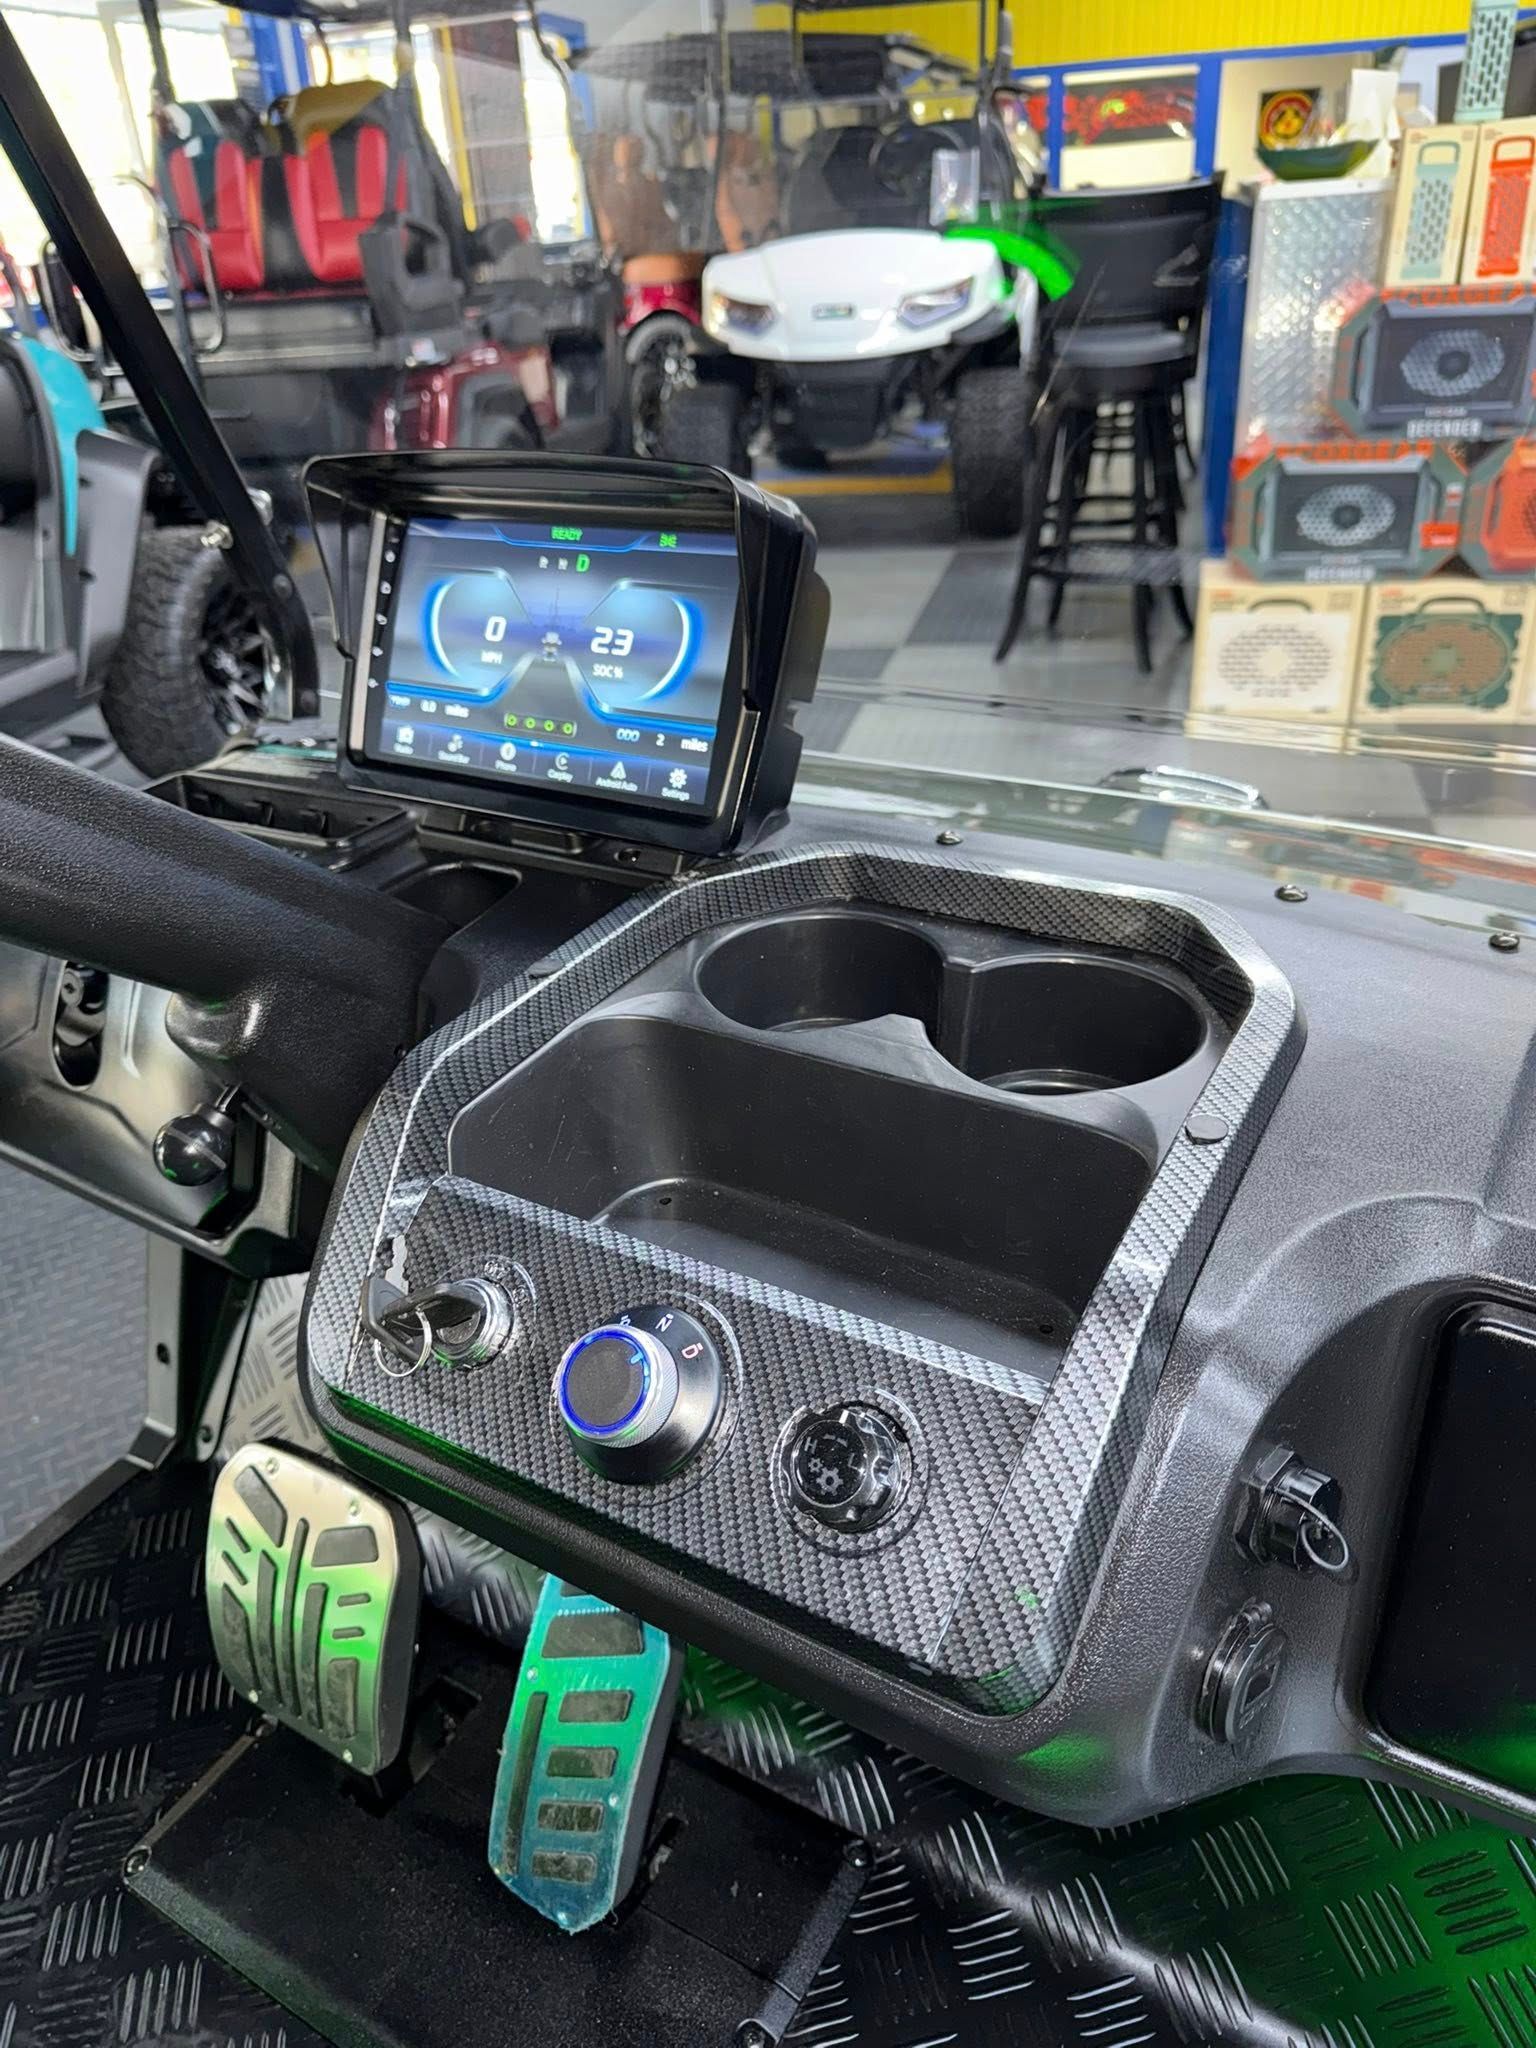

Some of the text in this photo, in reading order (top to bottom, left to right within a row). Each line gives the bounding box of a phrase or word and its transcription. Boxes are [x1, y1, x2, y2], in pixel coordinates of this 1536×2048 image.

[551, 525, 583, 541] READY
[576, 553, 590, 572] D
[485, 616, 507, 642] 0
[590, 626, 634, 656] 23
[481, 651, 503, 664] MPH
[656, 733, 665, 747] 2
[681, 738, 708, 753] miles
[661, 787, 690, 801] Settings
[655, 1316, 673, 1332] N
[681, 1343, 700, 1359] D
[804, 1436, 819, 1454] H
